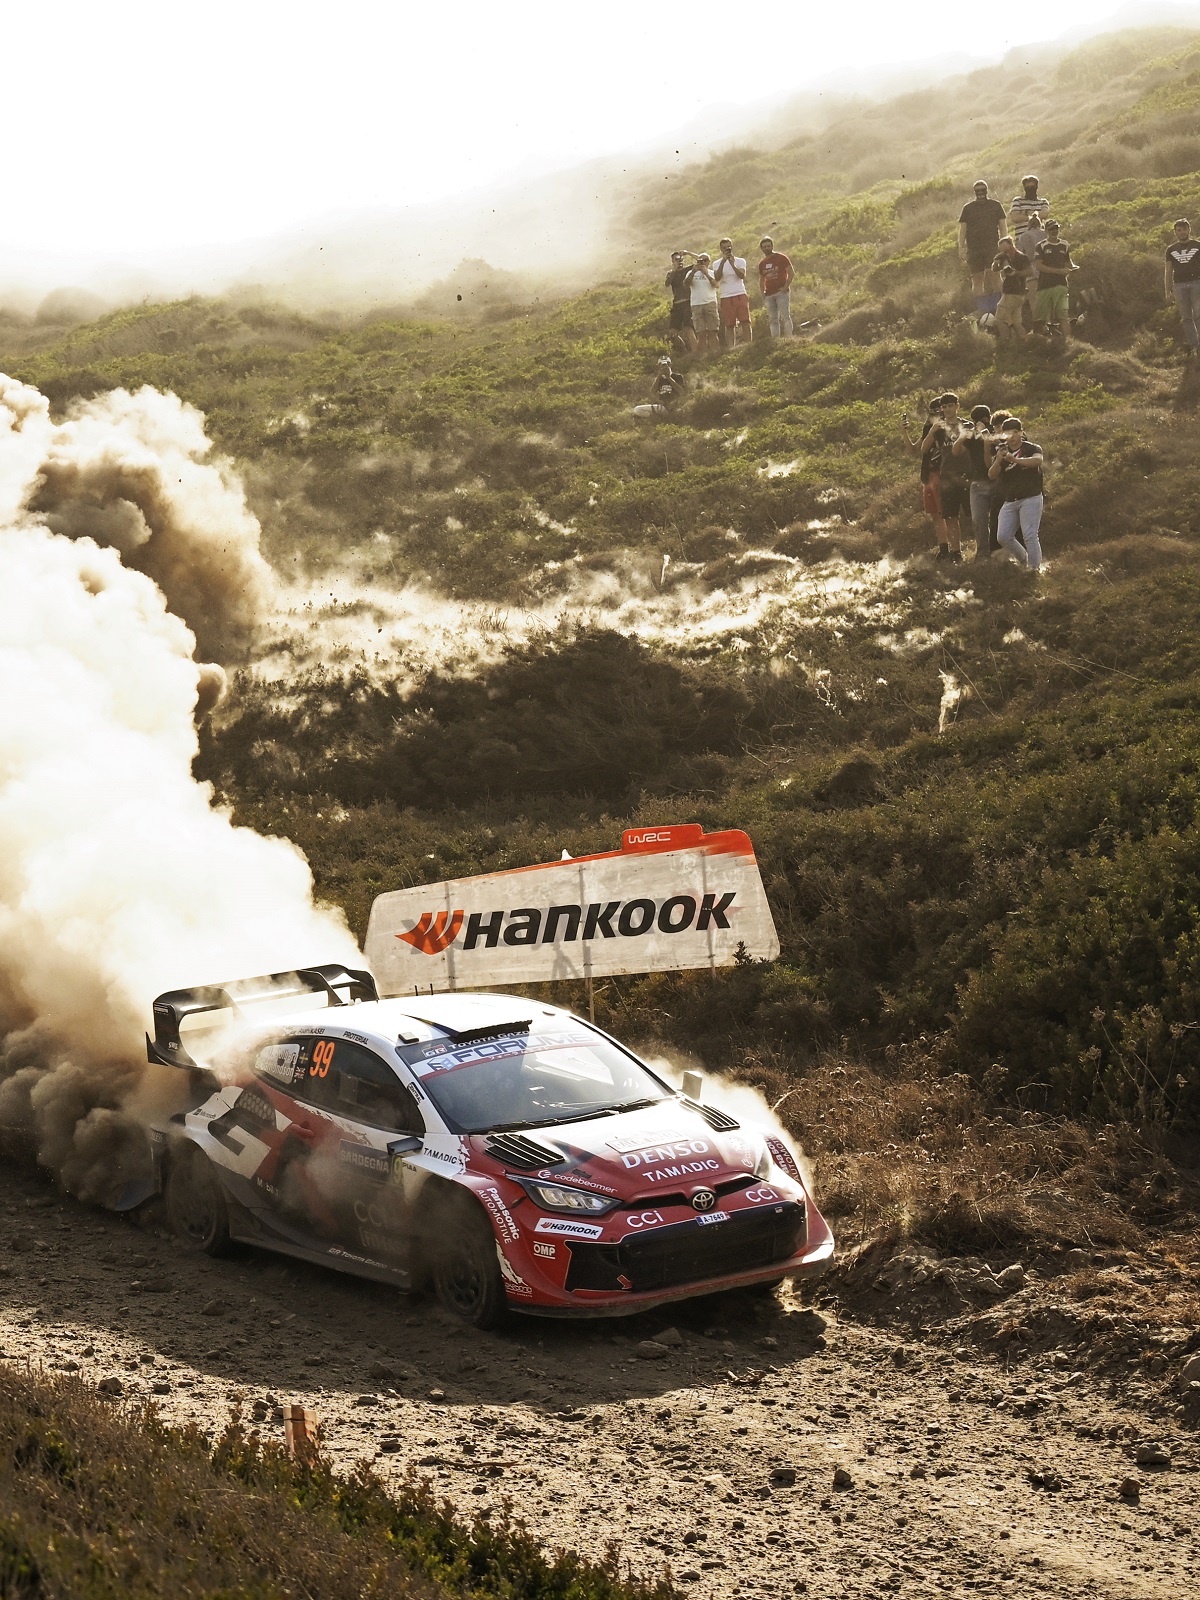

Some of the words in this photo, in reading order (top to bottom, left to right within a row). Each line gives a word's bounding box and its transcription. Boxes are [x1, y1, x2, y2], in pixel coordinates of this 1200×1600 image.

[627, 831, 671, 844] WRC
[342, 1030, 369, 1045] PROTERIAL
[448, 1035, 496, 1050] TOYOTA
[309, 1040, 336, 1078] 99
[341, 1150, 390, 1173] SARDEGNA
[423, 1147, 458, 1164] TAMADIC
[621, 1140, 709, 1169] DENSO
[402, 1162, 417, 1173] PIAA
[642, 1159, 720, 1182] TAMADIC
[256, 1177, 275, 1195] Mbil
[554, 1173, 618, 1193] codebeamer
[476, 1189, 513, 1244] AUTOMOTIVE
[486, 1187, 520, 1240] Panasonic
[702, 1213, 726, 1225] A-7649
[533, 1245, 556, 1257] OMP
